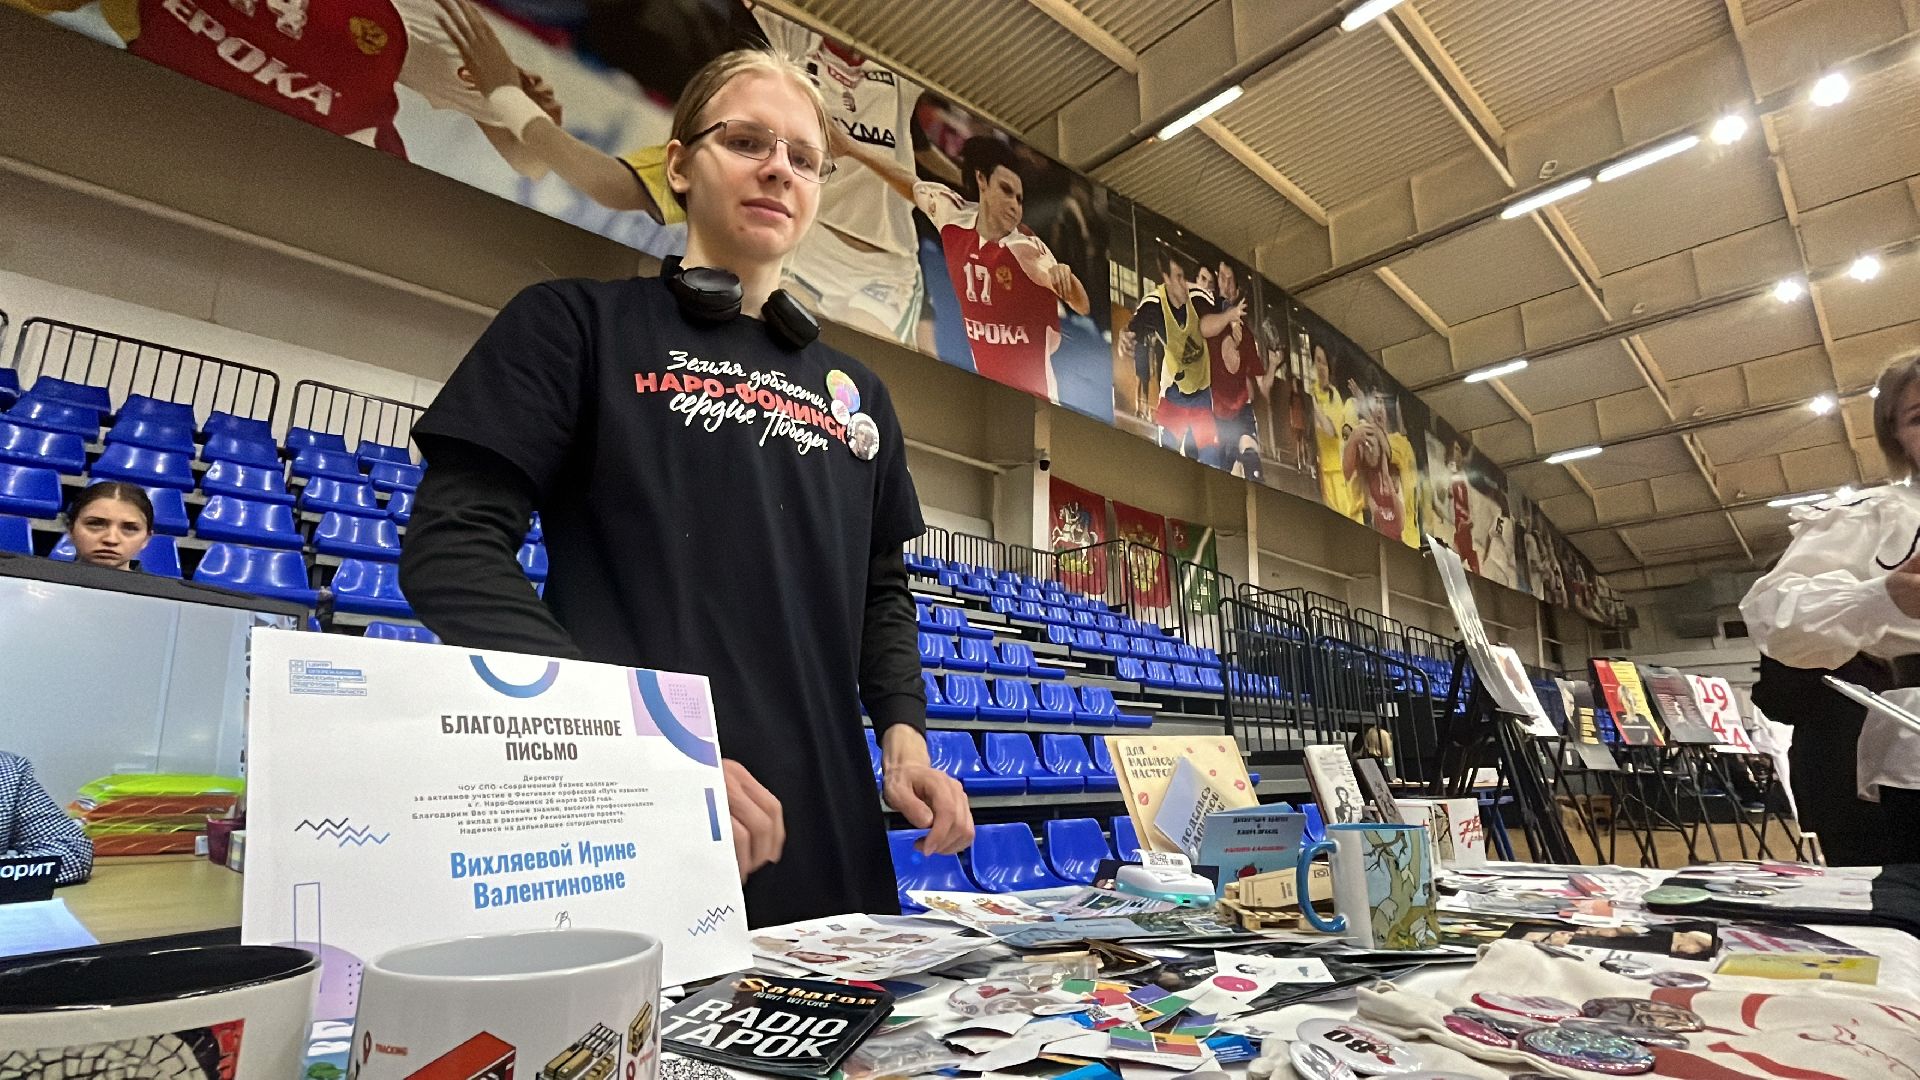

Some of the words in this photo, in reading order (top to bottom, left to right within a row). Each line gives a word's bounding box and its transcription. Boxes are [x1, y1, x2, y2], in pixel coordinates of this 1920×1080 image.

[963, 262, 992, 306] 17
[964, 318, 1029, 344] EPOKA
[667, 350, 747, 377] Земля
[748, 370, 828, 413] доблести,
[634, 372, 847, 444] НАРО-ФОМИНСК
[669, 392, 756, 432] сердце
[759, 409, 828, 455] Победы
[1697, 677, 1728, 710] 19
[441, 715, 622, 738] БЛАГОДАРСТВЕННОЕ
[505, 742, 578, 760] ПИСЬМО
[450, 842, 573, 879] Вихляевой
[578, 841, 637, 867] Ирине
[473, 871, 626, 909] Валентиновне
[660, 1015, 838, 1059] TAPOK
[687, 998, 848, 1038] RADIO
